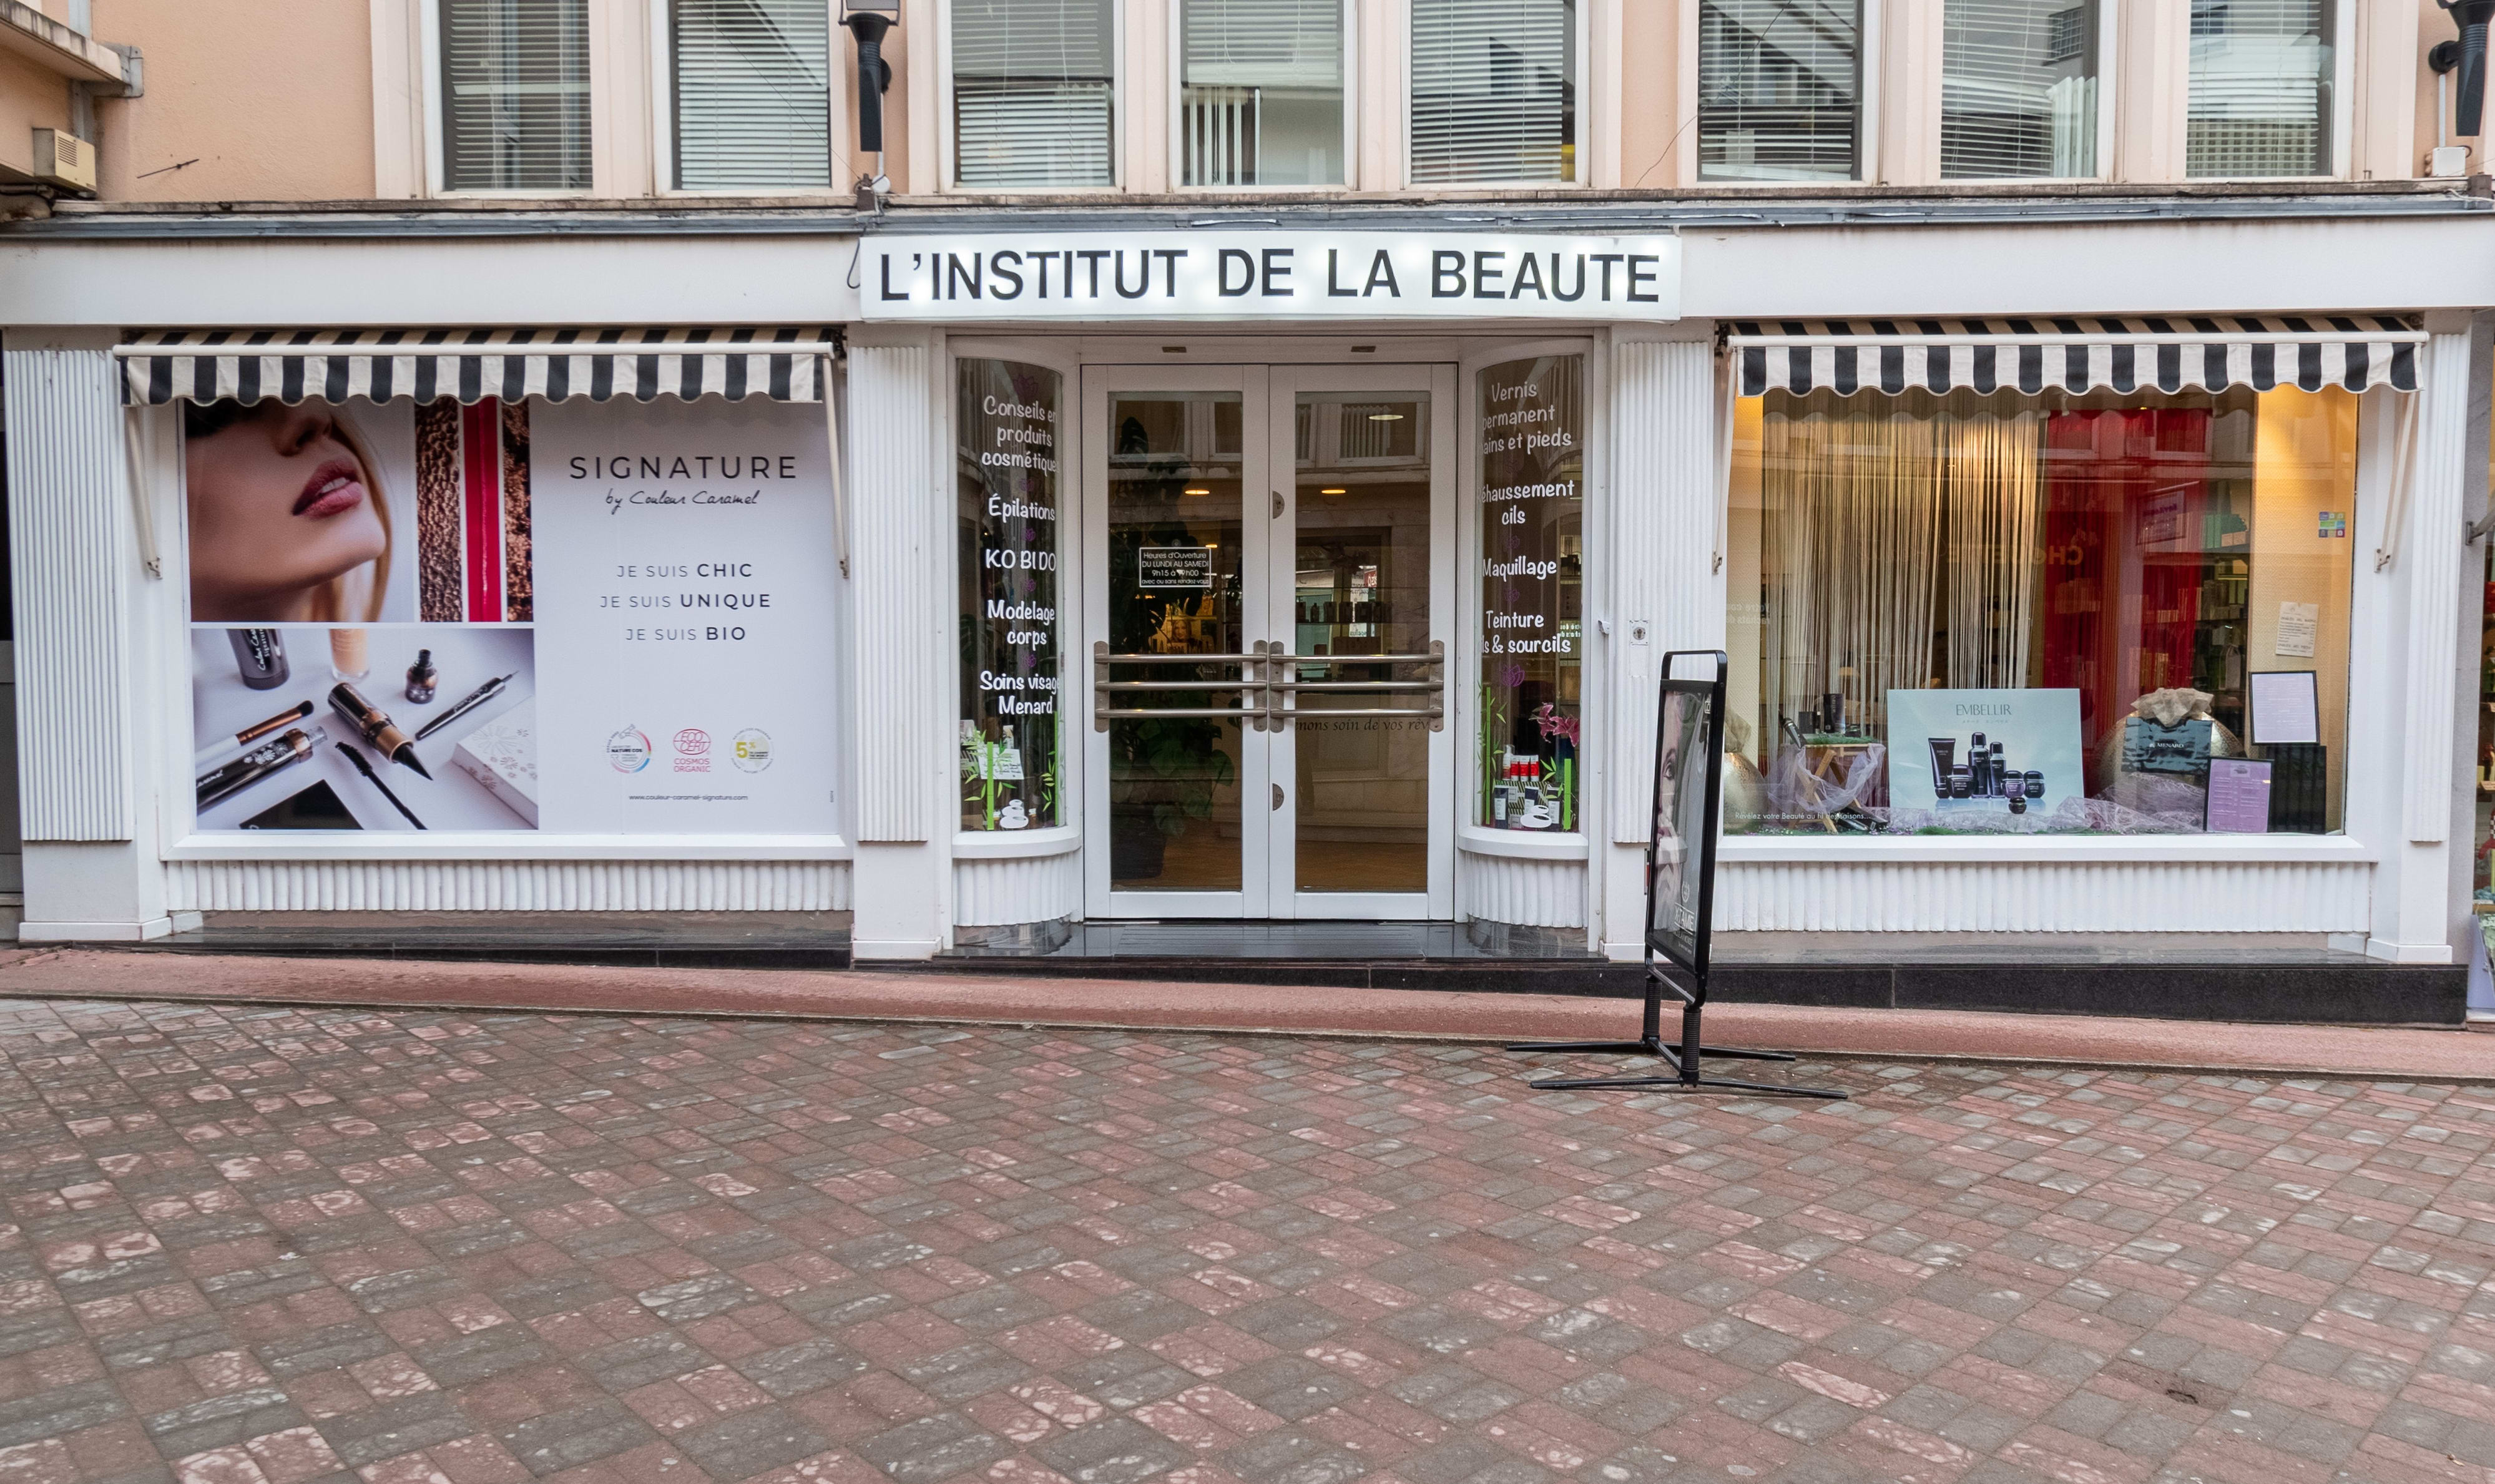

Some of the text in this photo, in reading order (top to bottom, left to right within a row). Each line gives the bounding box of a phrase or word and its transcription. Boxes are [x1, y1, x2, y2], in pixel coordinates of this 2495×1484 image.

[880, 248, 1660, 303] L'INSTITUT DE LA BEAUTE
[1492, 381, 1537, 403] Vernis
[984, 395, 1045, 421] Conseils
[1483, 404, 1555, 431] permanent
[997, 424, 1052, 447] produits
[1508, 433, 1522, 450] et
[1527, 427, 1572, 455] pieds
[570, 456, 797, 479] SIGNATURE
[605, 489, 759, 515] by Couleur Caramel
[989, 493, 1055, 523] Épilations
[1502, 505, 1526, 525] cils
[617, 564, 753, 577] JE SUIS CHIC
[1483, 555, 1557, 582] Maquillage
[600, 593, 771, 610] JE SUIS UNIQUE
[987, 600, 1055, 626] Modelage
[1486, 610, 1544, 628] Teinture
[625, 627, 746, 640] JE SUIS BIO
[1007, 630, 1047, 651] corps
[1492, 634, 1503, 653] &
[1508, 633, 1571, 653] sourcils
[980, 670, 1024, 690] Soins
[999, 695, 1052, 715] Menard
[1956, 704, 2012, 716] EMBELLIR
[1333, 720, 1359, 730] soin
[1364, 718, 1378, 730] de
[1384, 721, 1403, 730] vos
